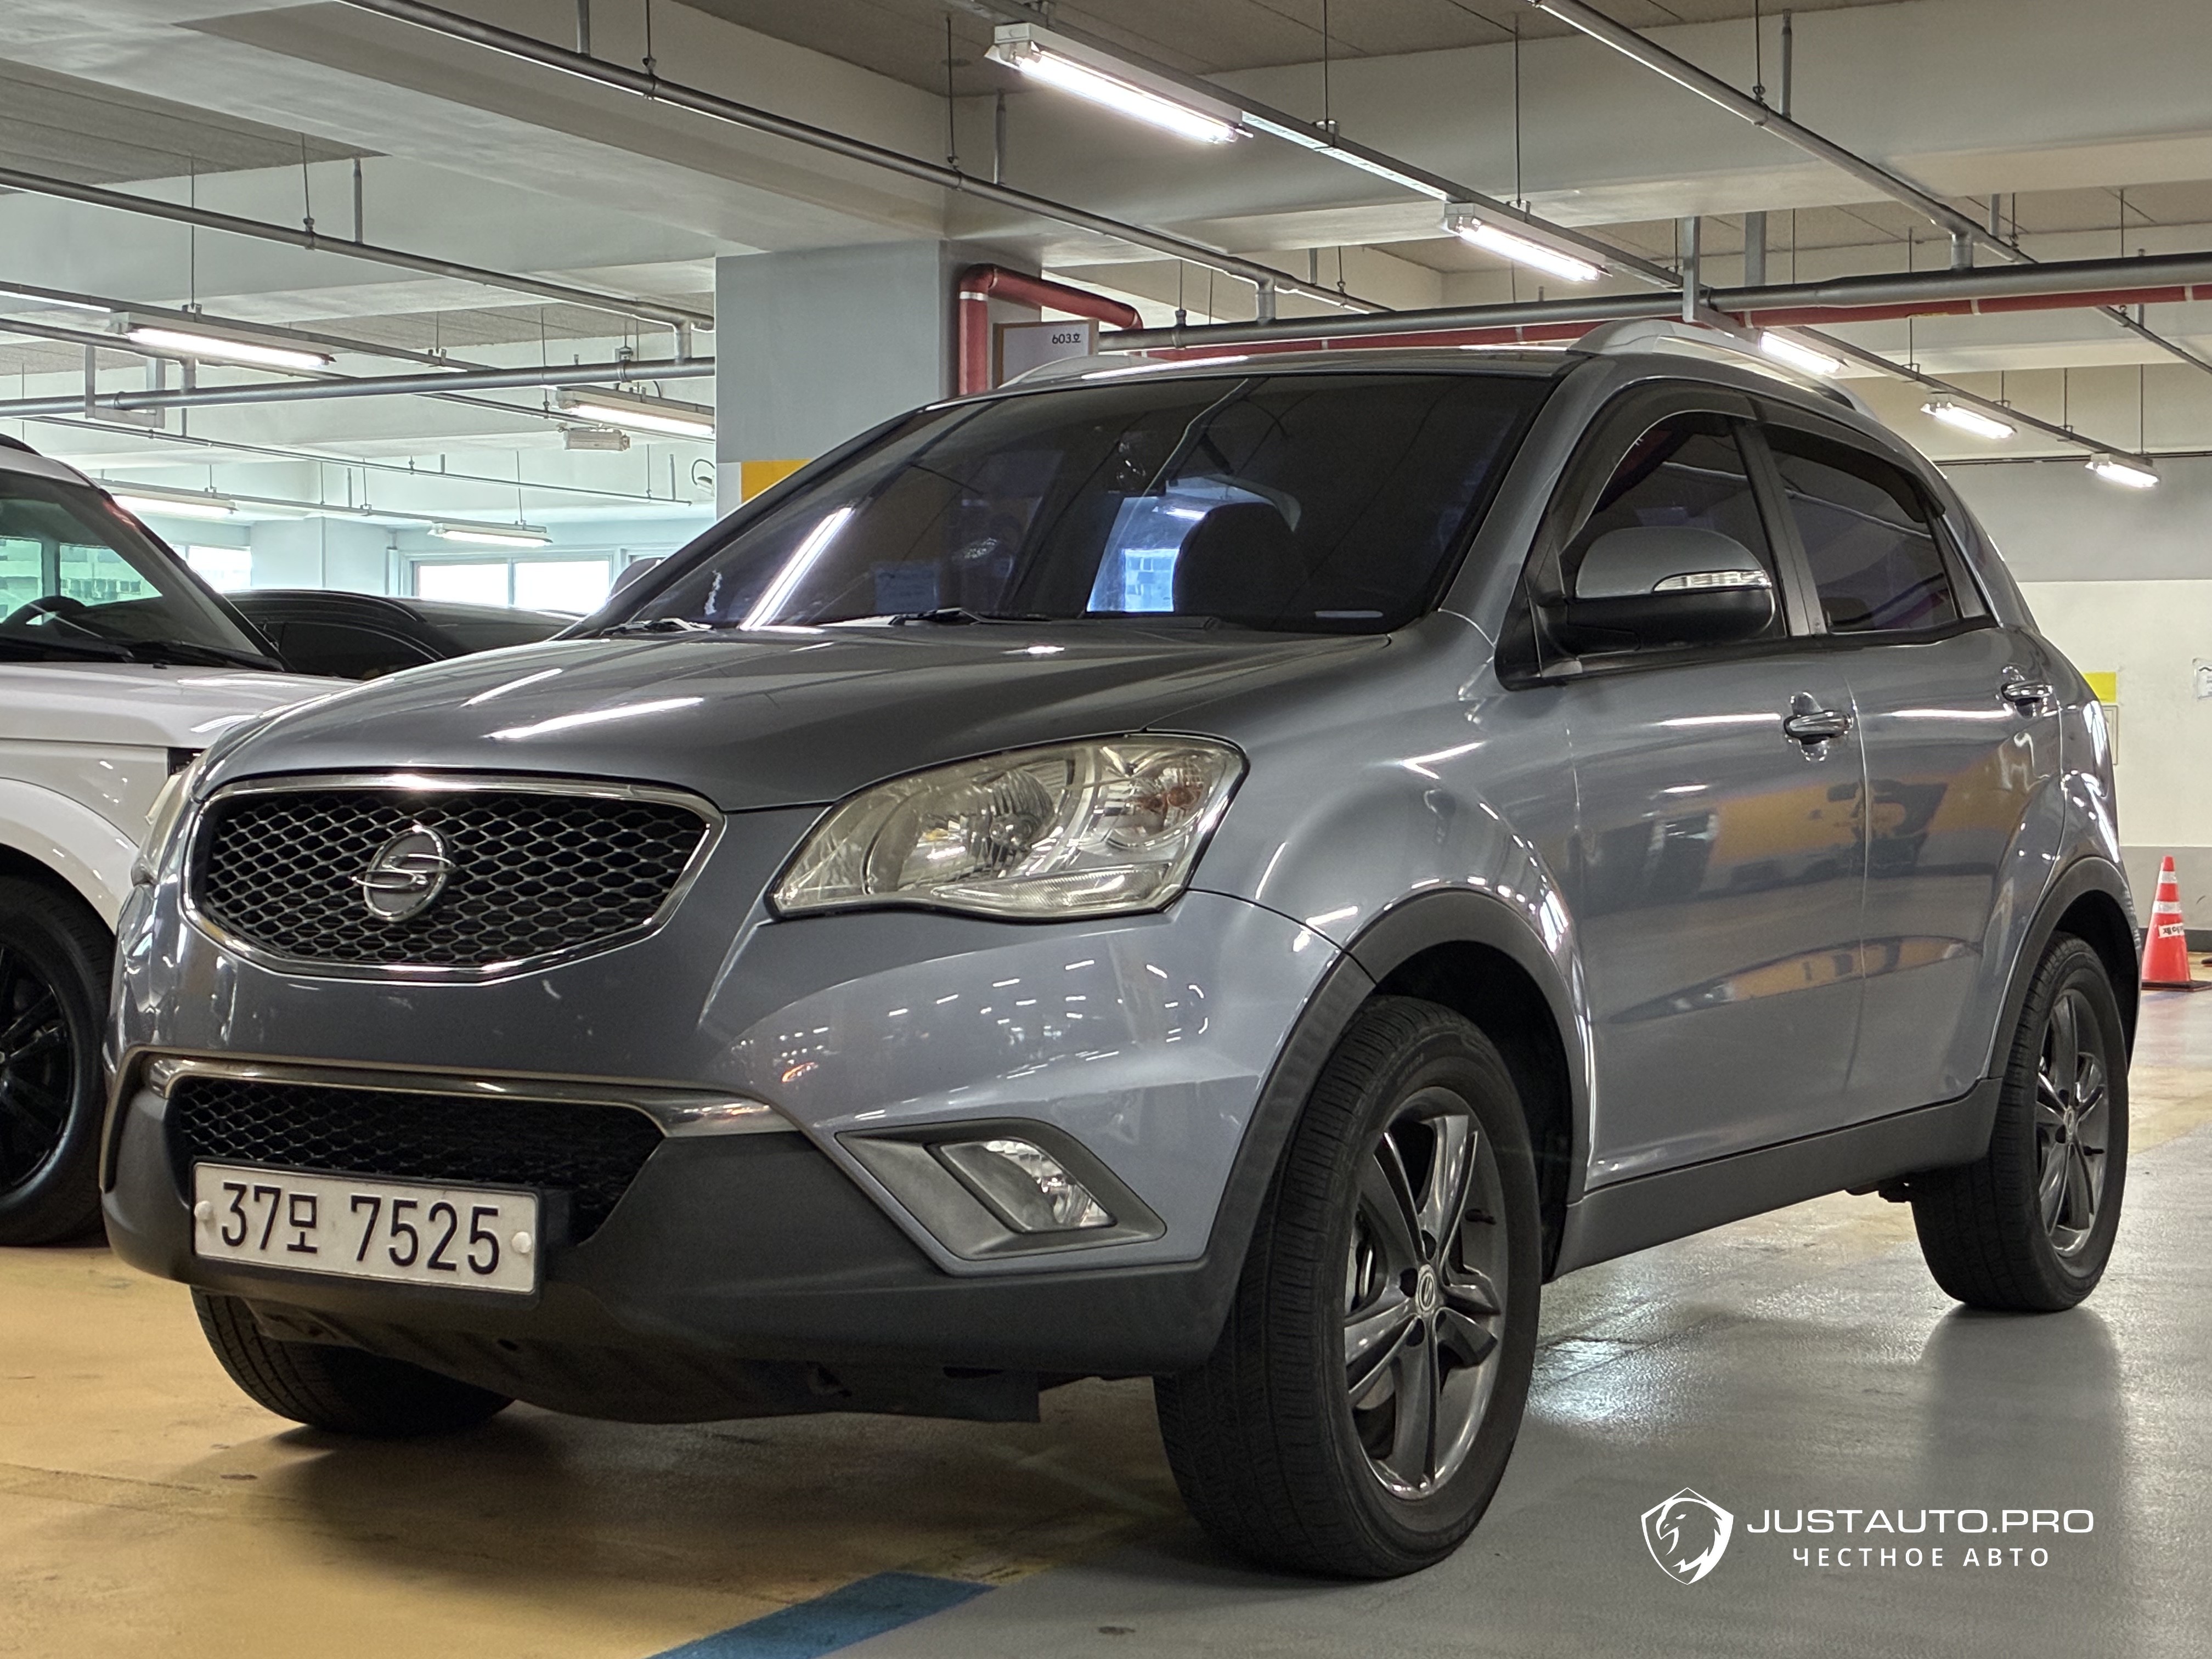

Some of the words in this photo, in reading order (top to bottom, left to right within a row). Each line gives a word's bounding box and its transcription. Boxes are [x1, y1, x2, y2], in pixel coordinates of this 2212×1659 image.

[1052, 332, 1081, 344] 603호
[221, 1181, 318, 1254] 37모
[350, 1194, 500, 1274] 7525
